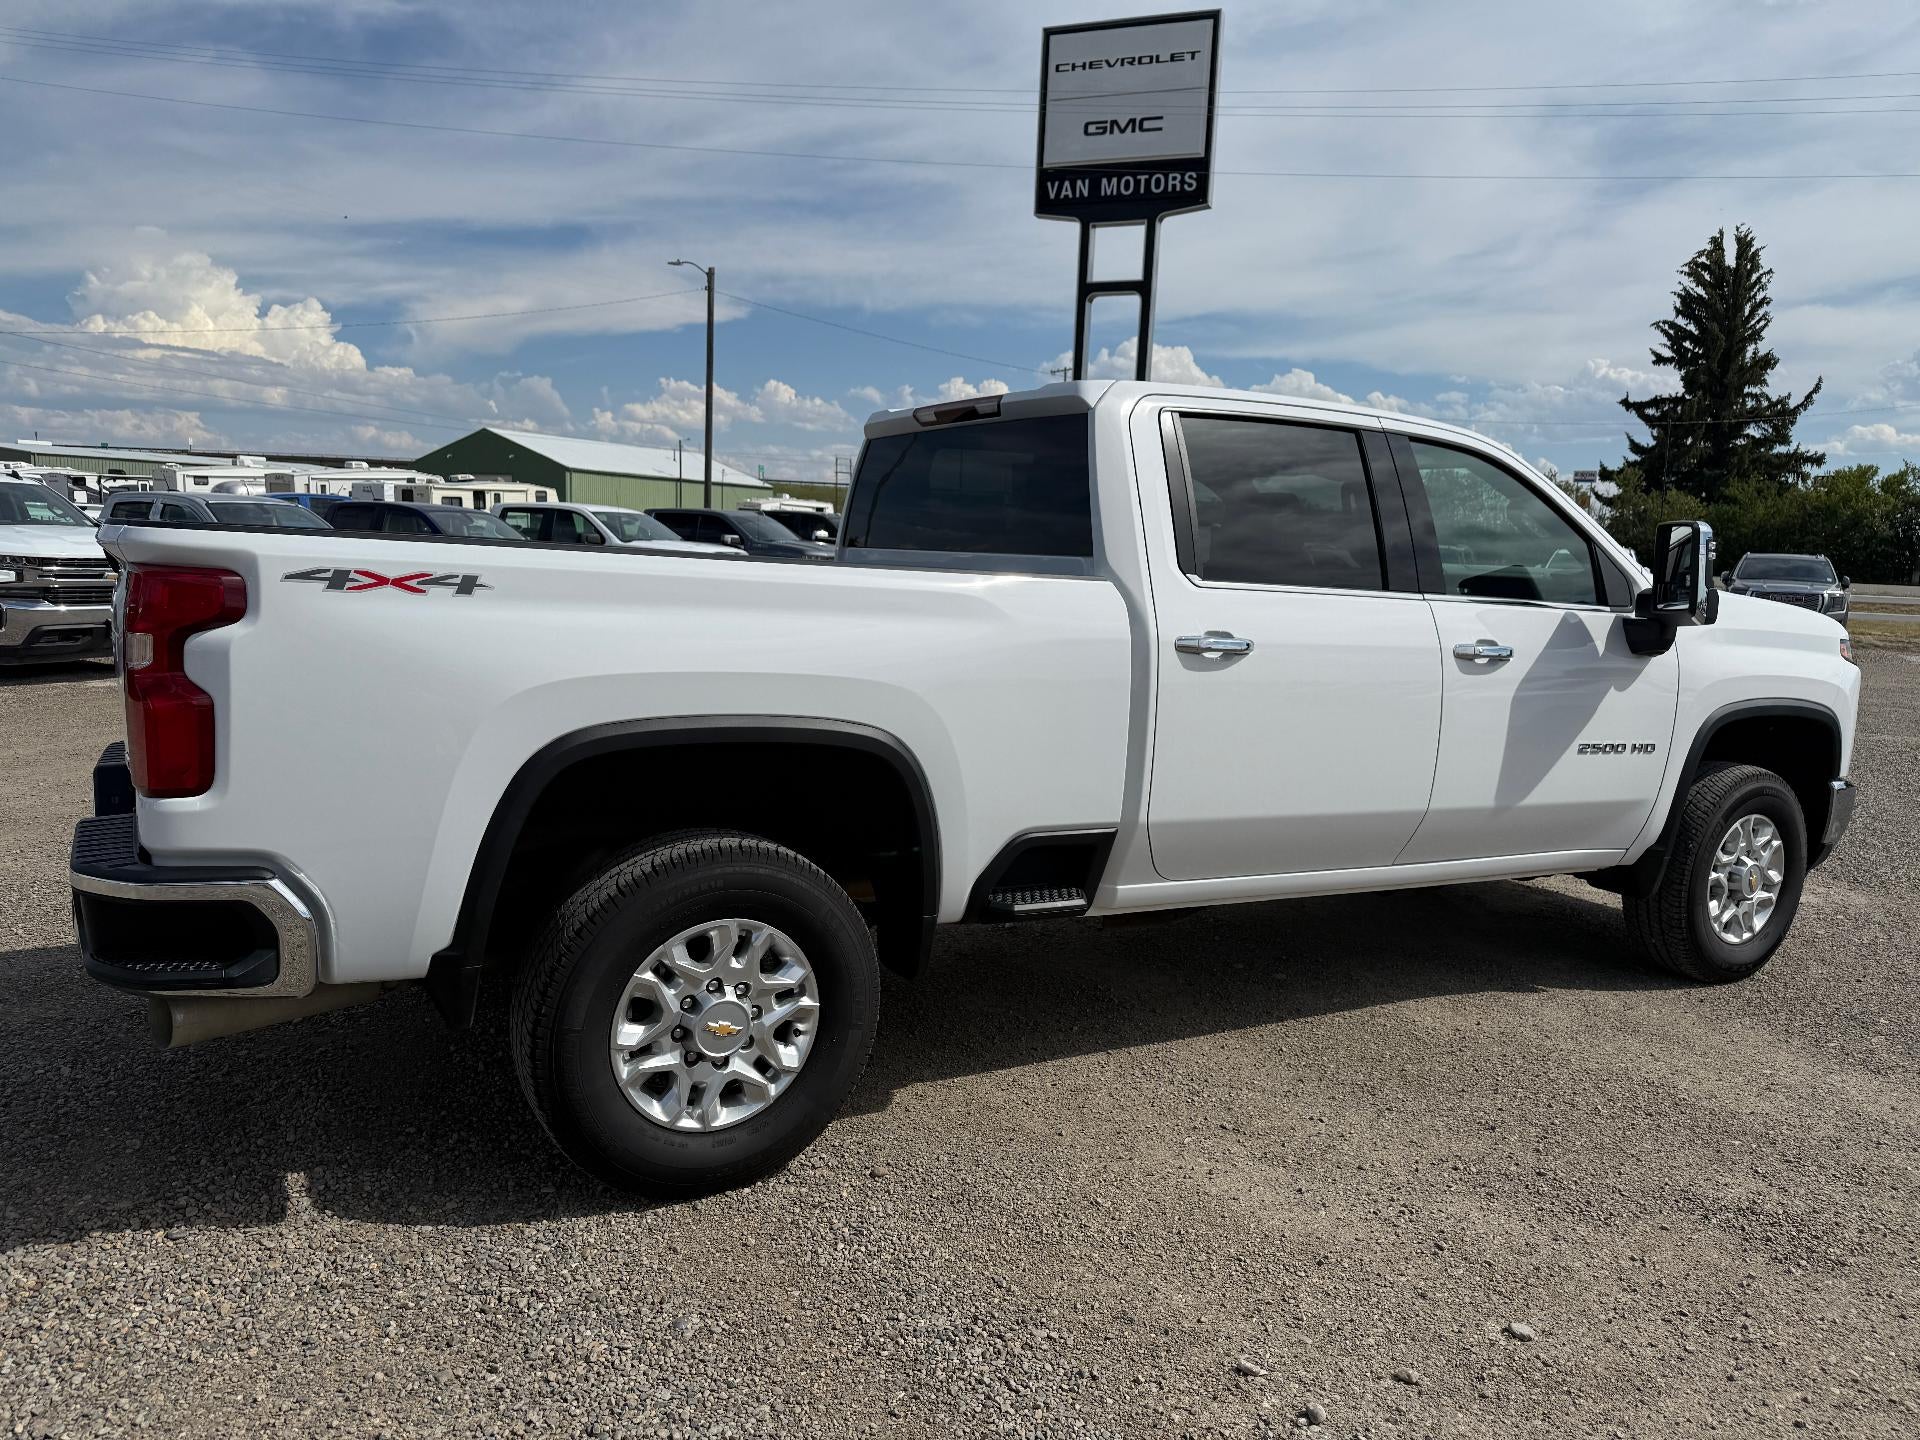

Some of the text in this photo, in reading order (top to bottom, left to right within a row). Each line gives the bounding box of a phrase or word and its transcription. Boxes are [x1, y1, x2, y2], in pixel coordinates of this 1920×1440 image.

[1055, 50, 1201, 73] CHEVROLET
[1083, 115, 1164, 137] GMC
[1047, 171, 1198, 200] VAN MOTORS
[1577, 743, 1656, 755] 2500 HD
